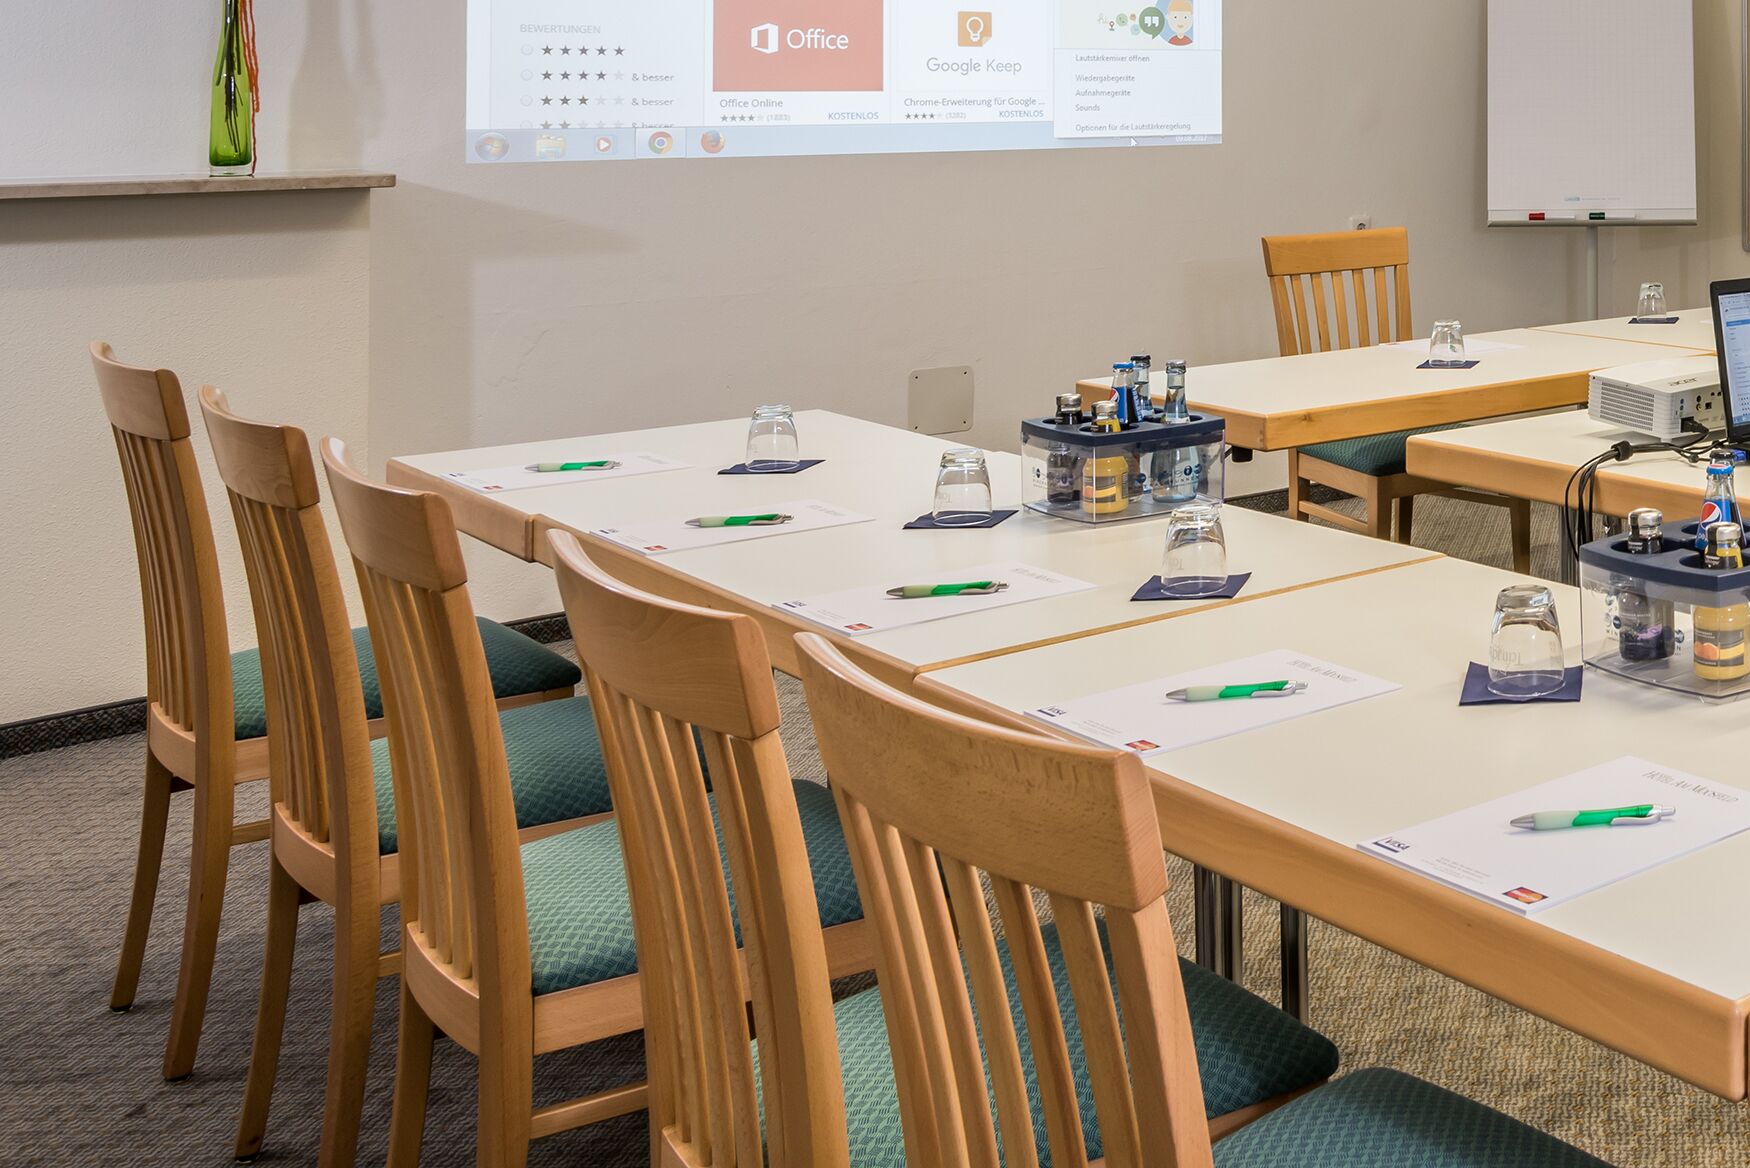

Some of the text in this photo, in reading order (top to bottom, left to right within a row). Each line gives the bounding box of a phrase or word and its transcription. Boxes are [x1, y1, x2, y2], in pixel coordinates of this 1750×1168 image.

[520, 23, 601, 34] BEWERTUNGEN
[786, 28, 849, 50] Office
[926, 57, 1022, 76] Google Keep
[642, 73, 674, 82] besser
[1075, 74, 1135, 84] Wiedergabegeräte
[1075, 89, 1131, 98] Aufnahmegeräte
[642, 97, 674, 106] besser
[720, 98, 784, 108] Office Online
[904, 97, 992, 108] Chrome-Erweiterung
[994, 97, 1006, 106] für
[1008, 97, 1037, 108] Google
[1075, 104, 1101, 112] Sounds
[828, 111, 880, 121] KOSTENLOS
[999, 110, 1044, 119] KOSTENLOS
[1075, 123, 1107, 133] Optionen
